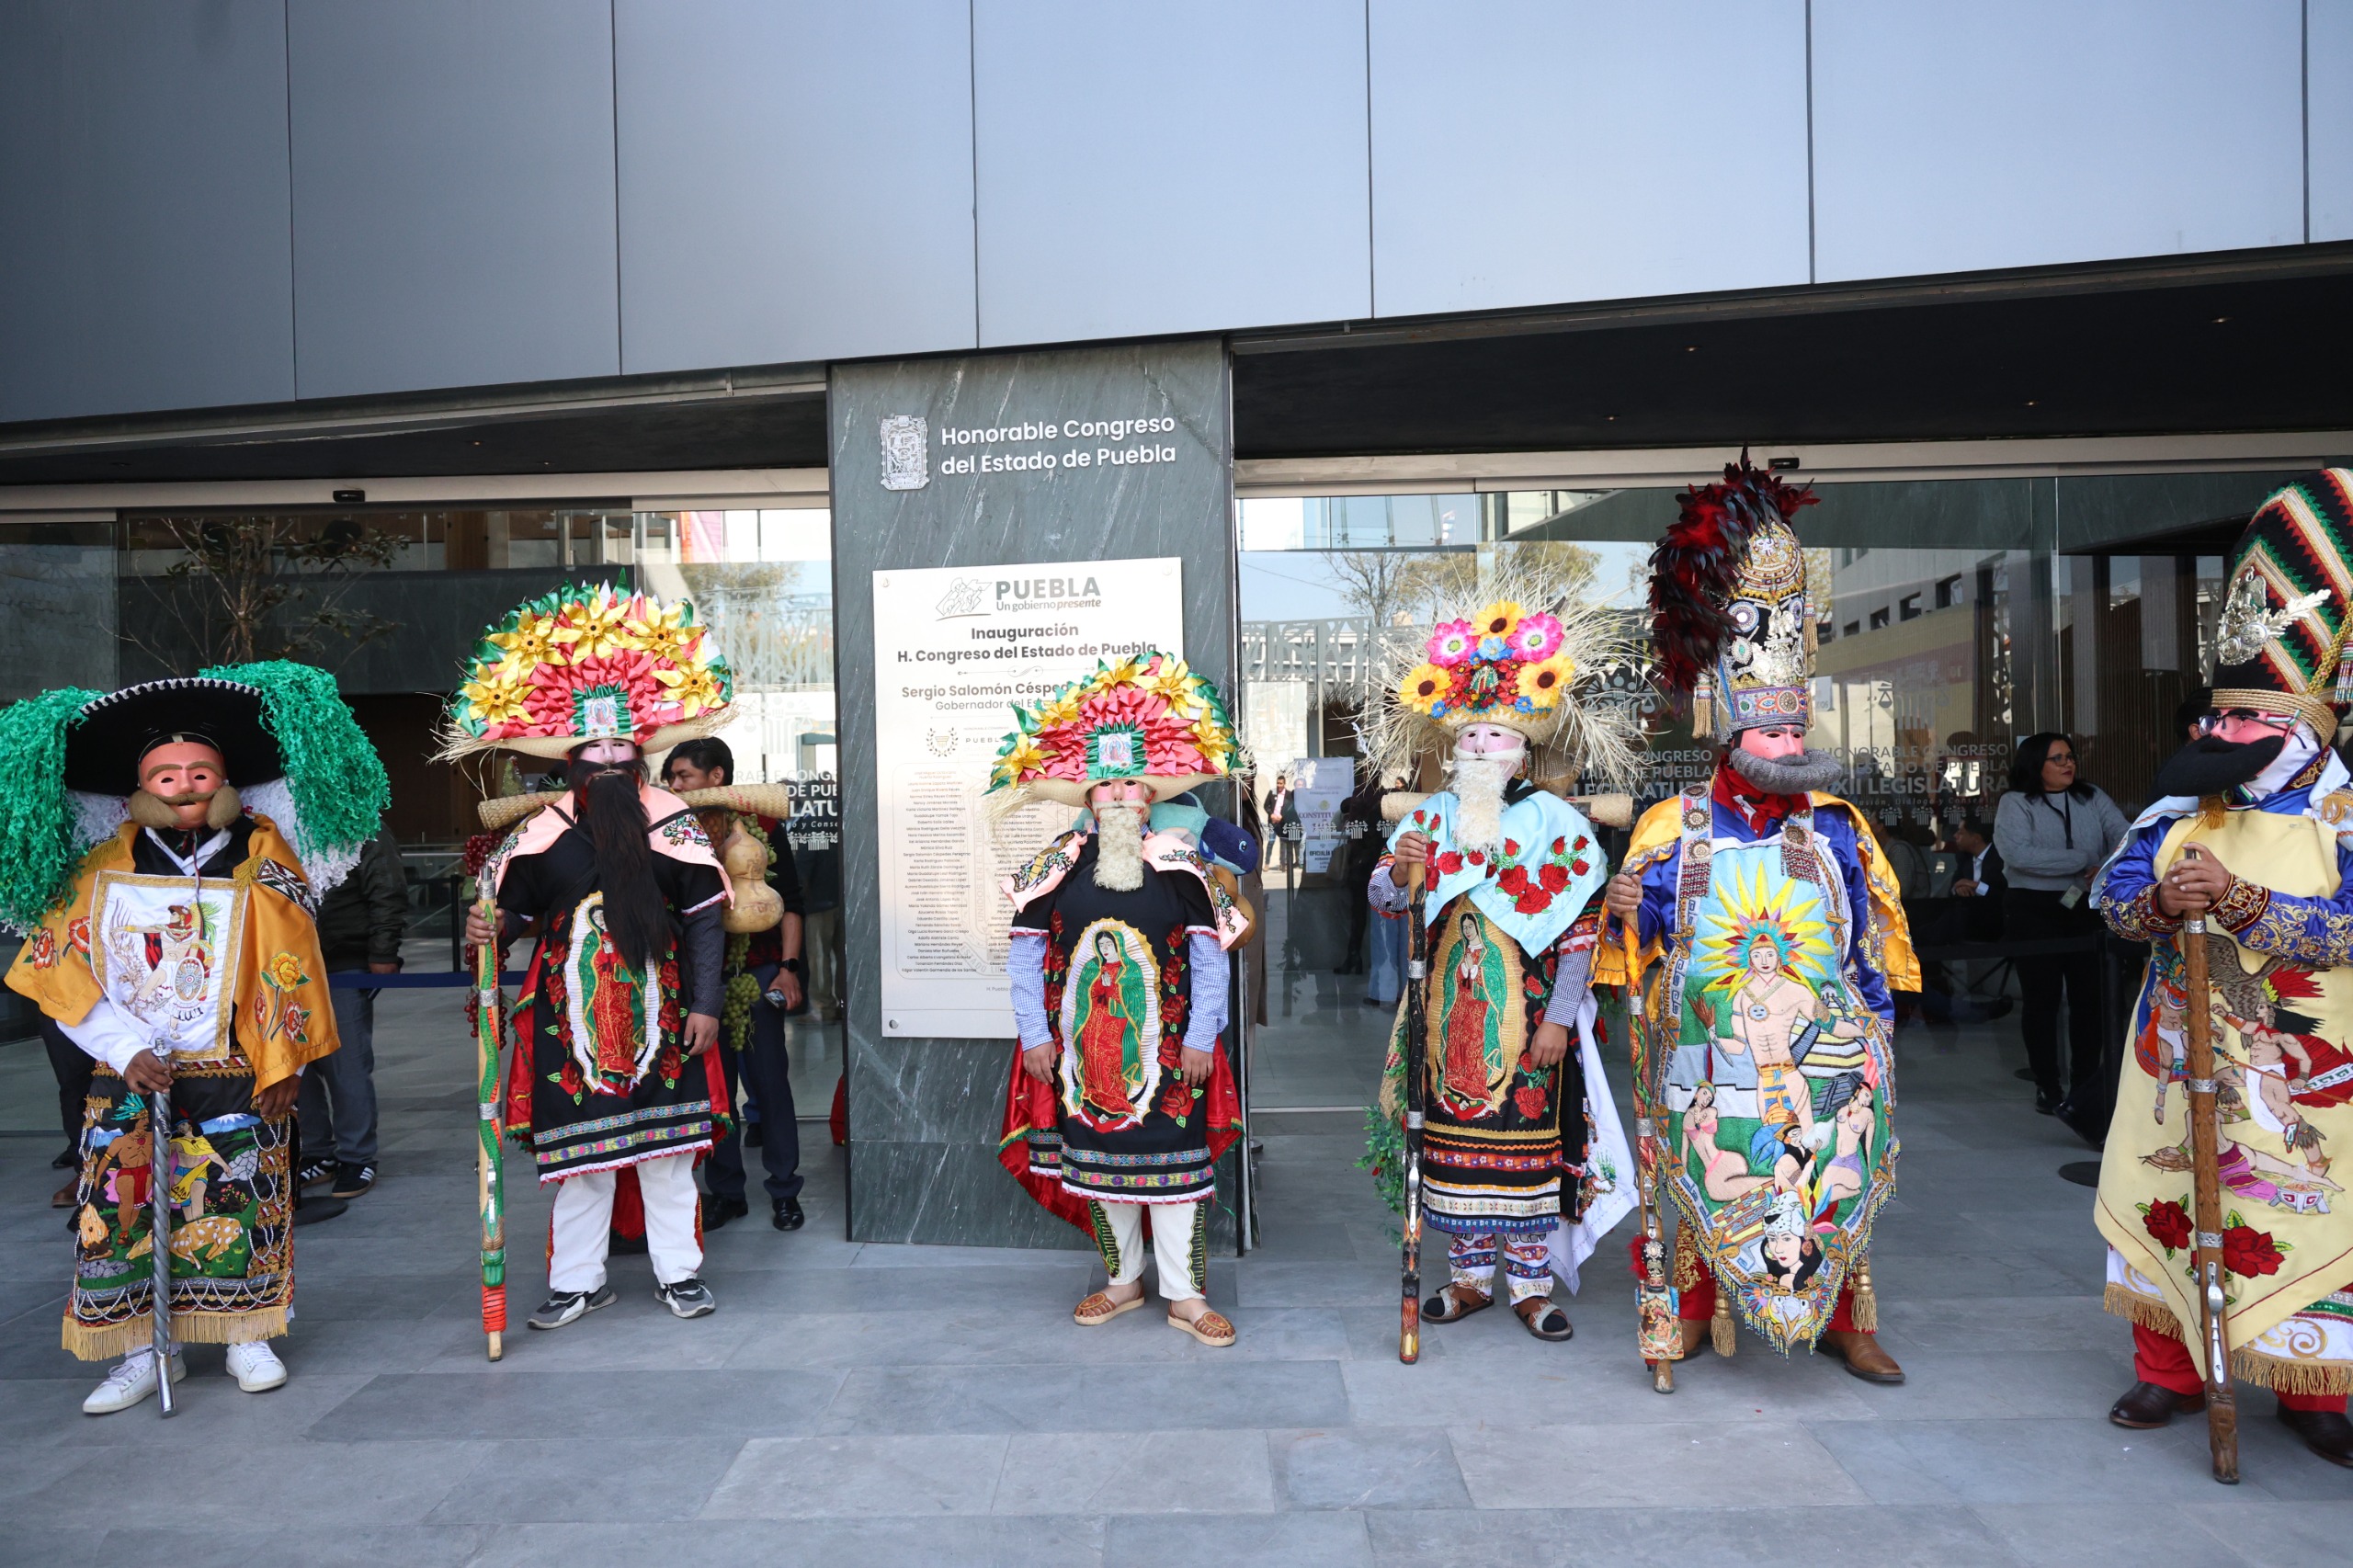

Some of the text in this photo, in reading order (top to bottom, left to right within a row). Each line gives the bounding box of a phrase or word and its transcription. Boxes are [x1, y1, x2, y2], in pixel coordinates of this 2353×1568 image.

[941, 416, 1176, 446] Honorable Congreso
[940, 444, 1176, 475] del Estado de Puebla
[995, 576, 1101, 600] PUEBLA
[996, 598, 1101, 612] Un gobierno presente
[971, 622, 1079, 642] Inauguración
[897, 642, 1157, 665] H. Congreso del Estado de Puebla
[902, 686, 946, 701] Sergio
[949, 683, 1012, 698] Salomón
[935, 699, 1005, 711] Gobernador
[1006, 699, 1024, 709] del
[1923, 744, 2009, 756] CONGRESO
[1653, 765, 1712, 778] PUEBLA
[1948, 759, 2009, 772] PUEBLA
[735, 770, 781, 782] RABLE
[1836, 775, 2010, 795] XII LEGISLATURA
[790, 800, 837, 817] LATU
